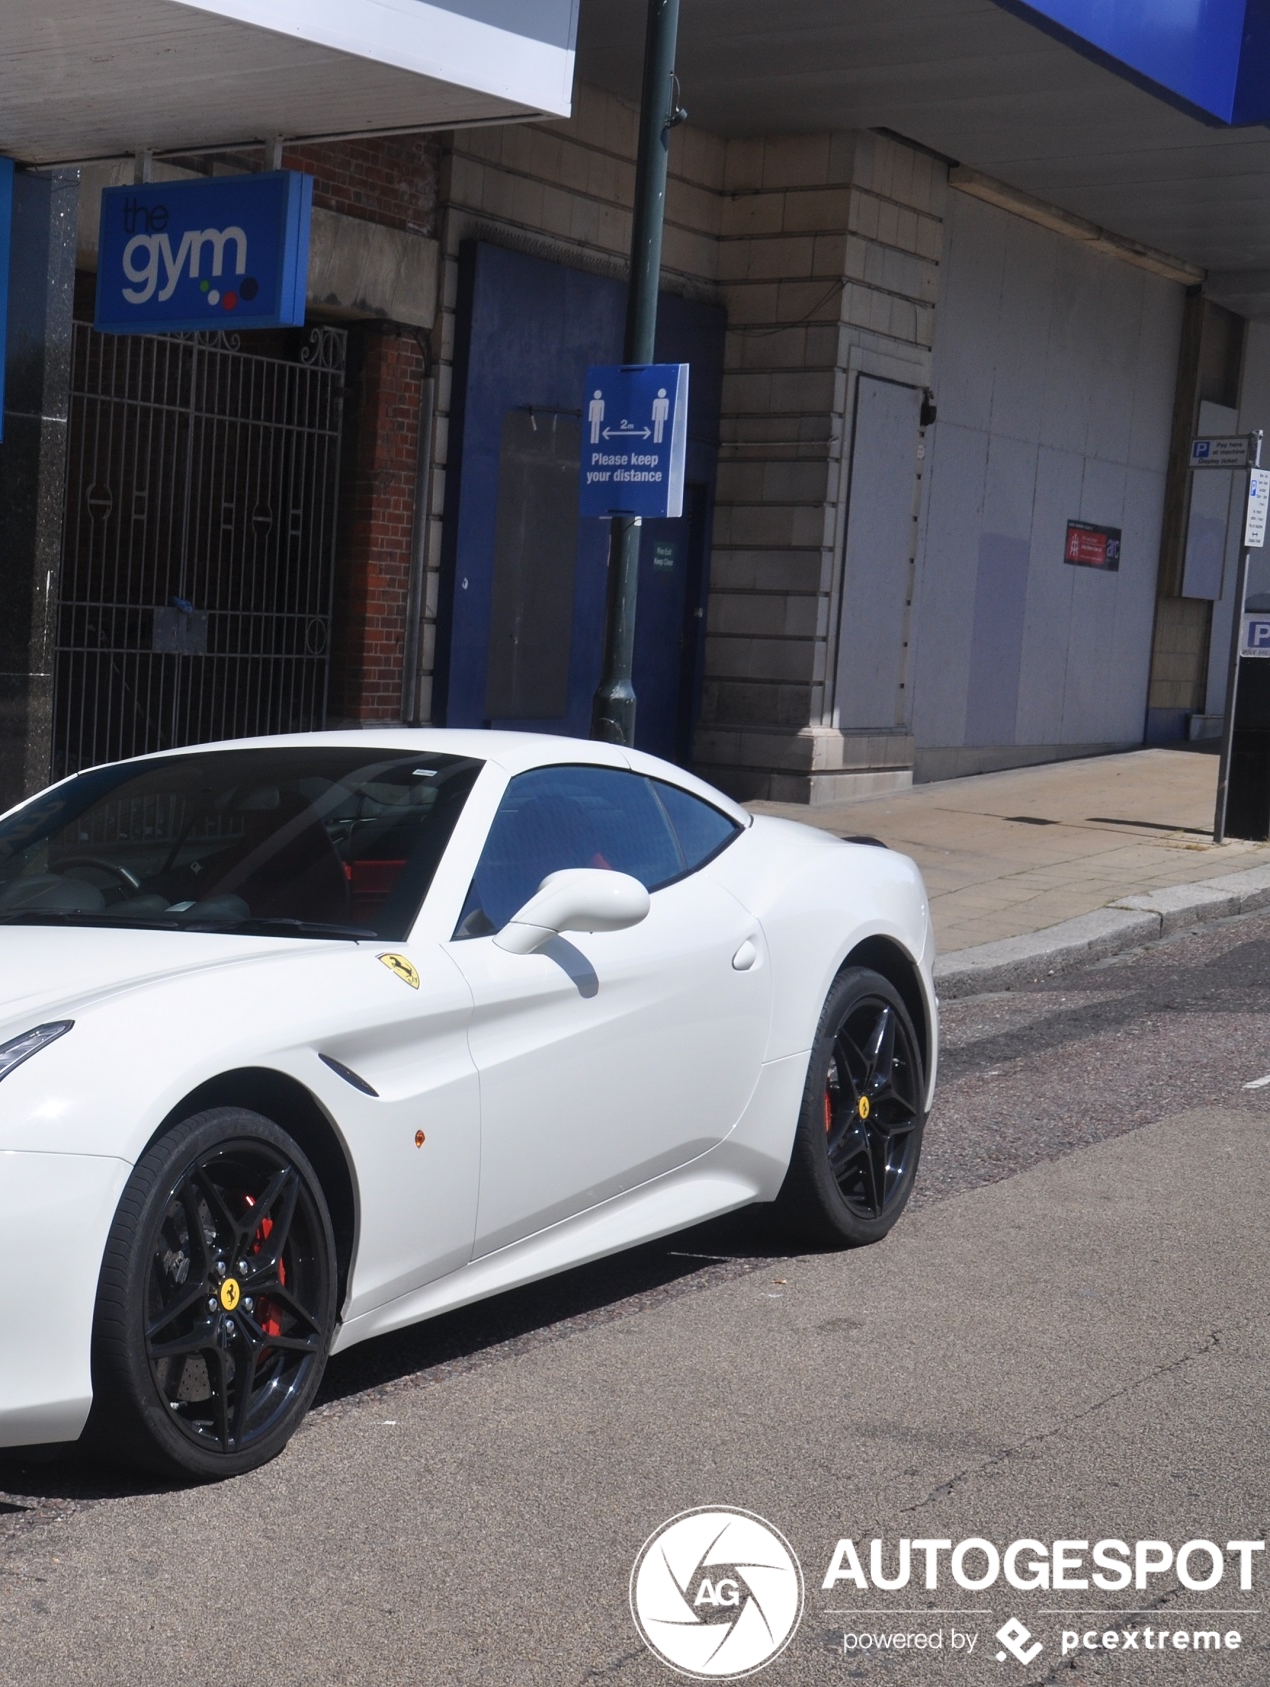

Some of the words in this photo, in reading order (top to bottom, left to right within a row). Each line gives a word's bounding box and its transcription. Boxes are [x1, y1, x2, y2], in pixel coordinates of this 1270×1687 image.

[122, 196, 170, 234] the
[121, 225, 248, 305] gym
[591, 452, 628, 466] Please
[631, 452, 659, 468] keep
[586, 471, 611, 485] your
[613, 469, 663, 482] distance
